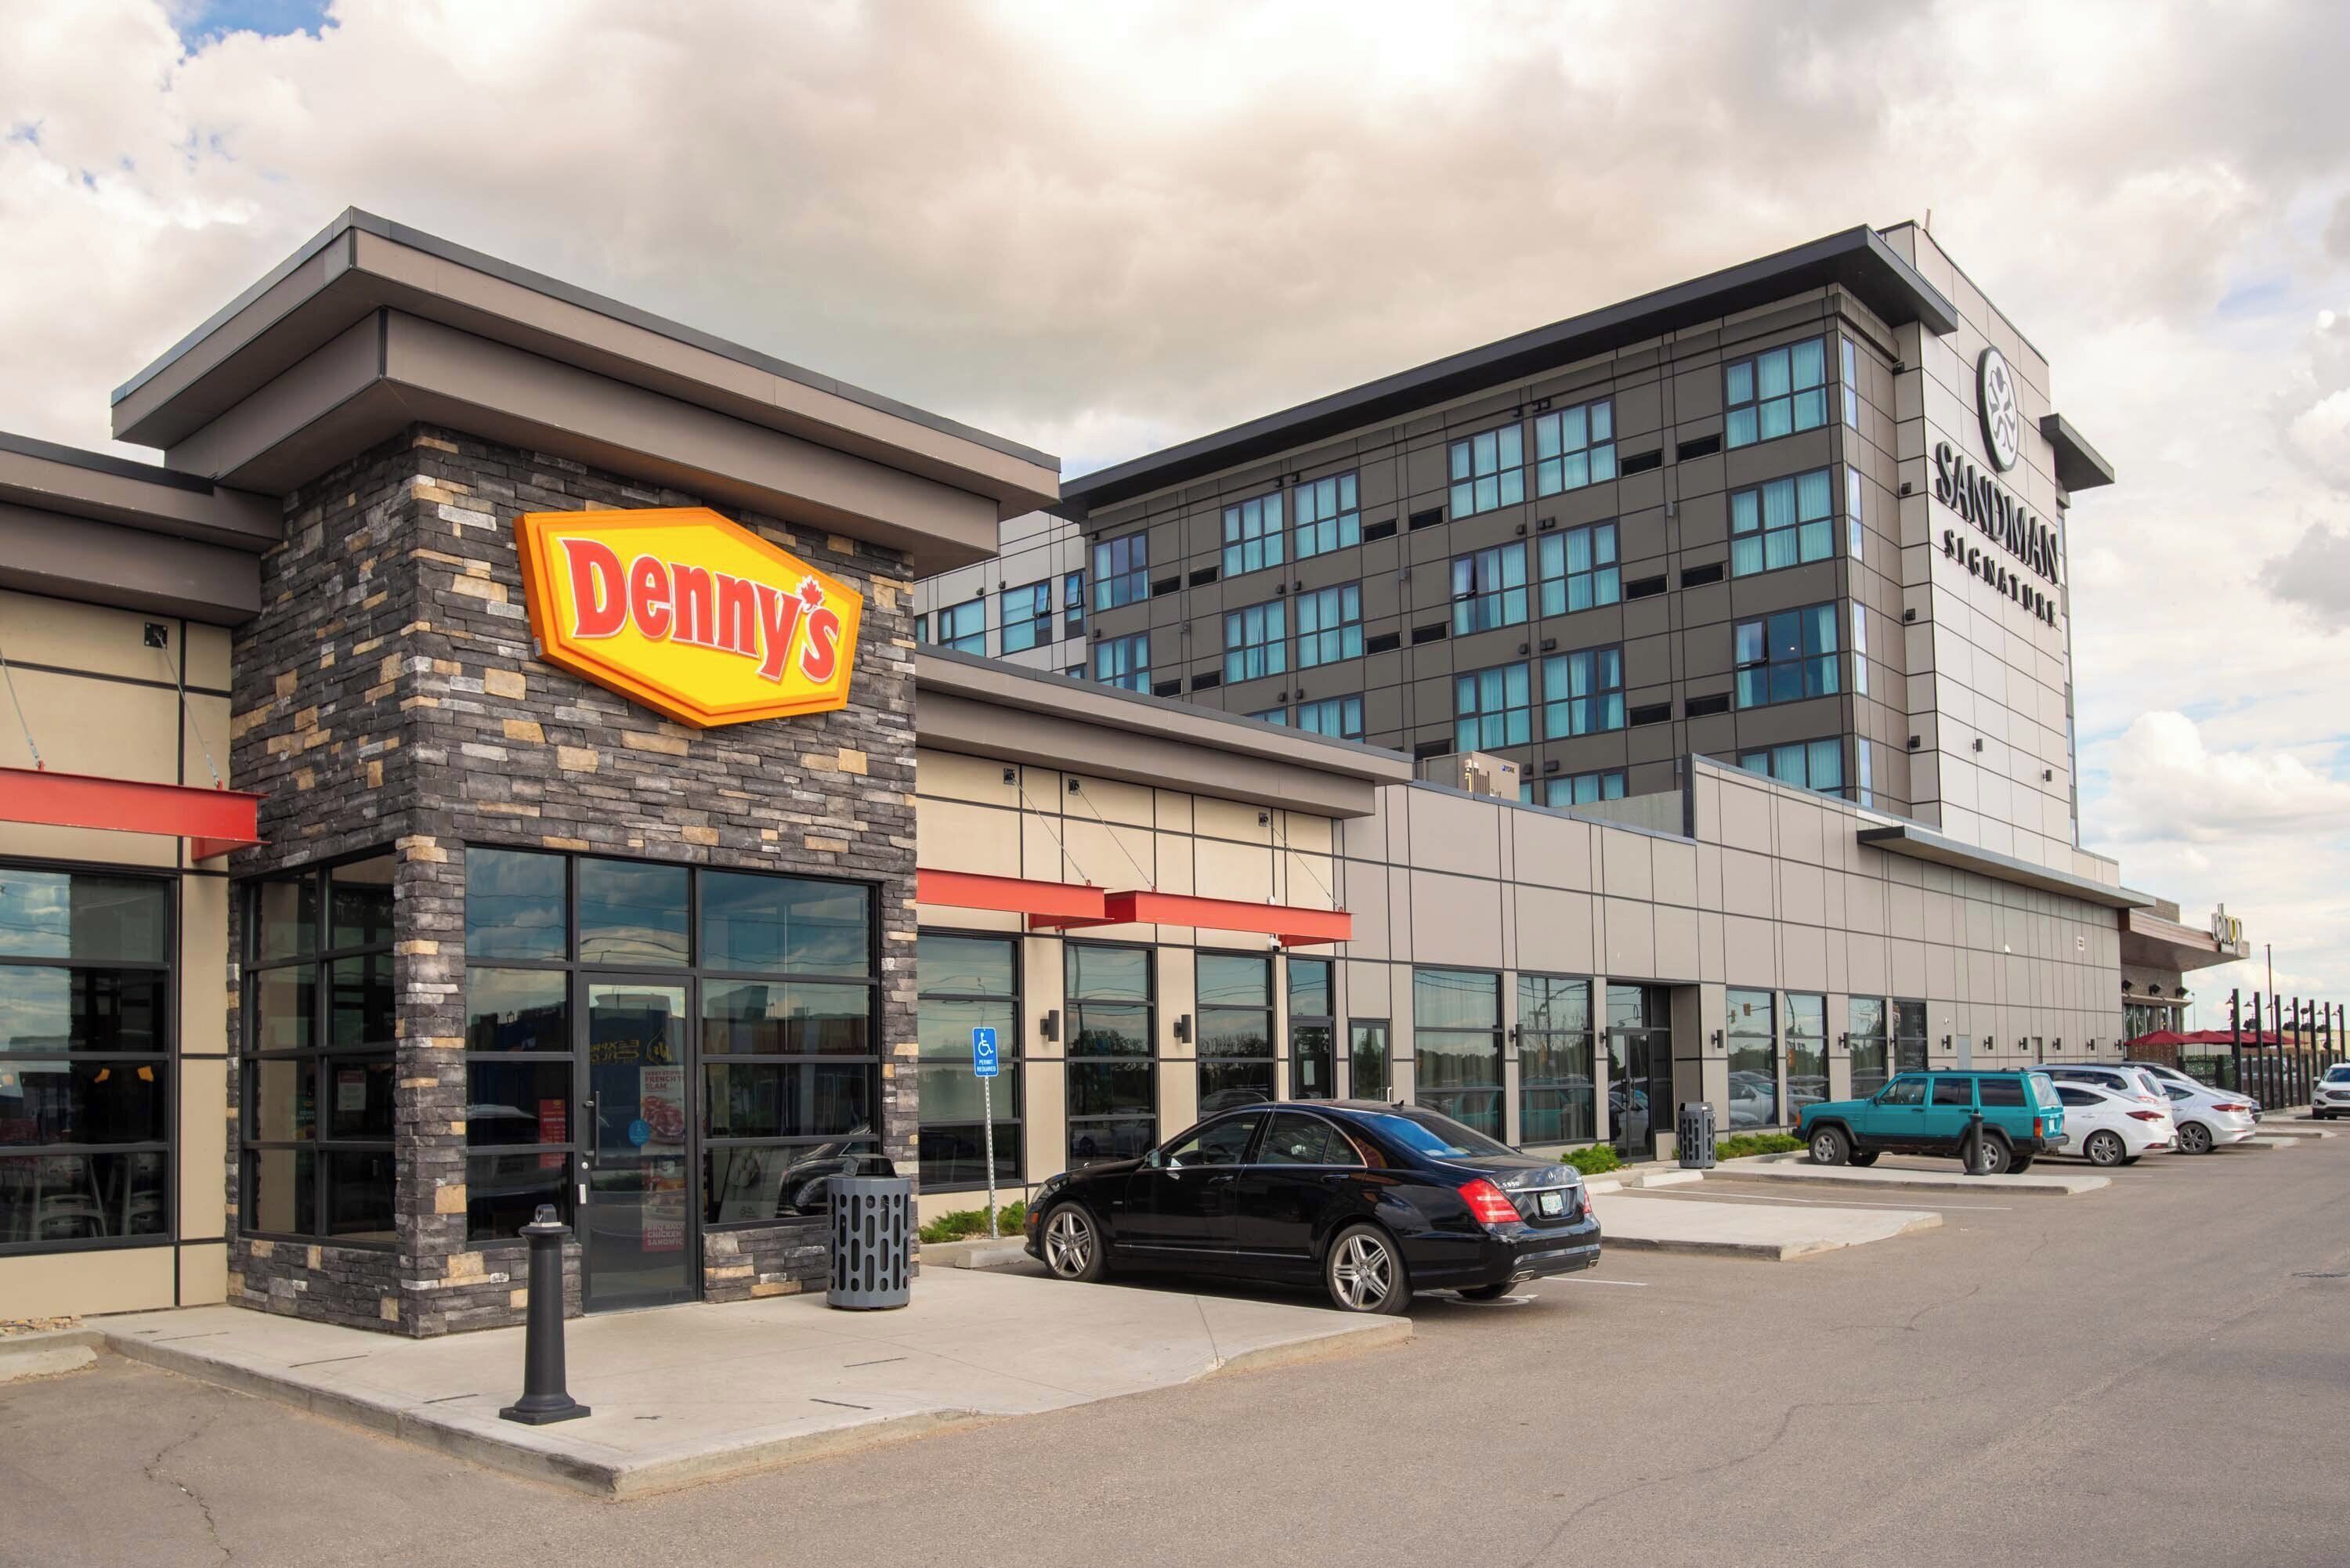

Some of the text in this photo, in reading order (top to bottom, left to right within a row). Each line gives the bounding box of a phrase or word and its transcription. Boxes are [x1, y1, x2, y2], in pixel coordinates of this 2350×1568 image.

[1936, 441, 2059, 584] SANDMAN
[1944, 529, 2056, 627] SIGNATURE
[557, 537, 840, 682] Denny's
